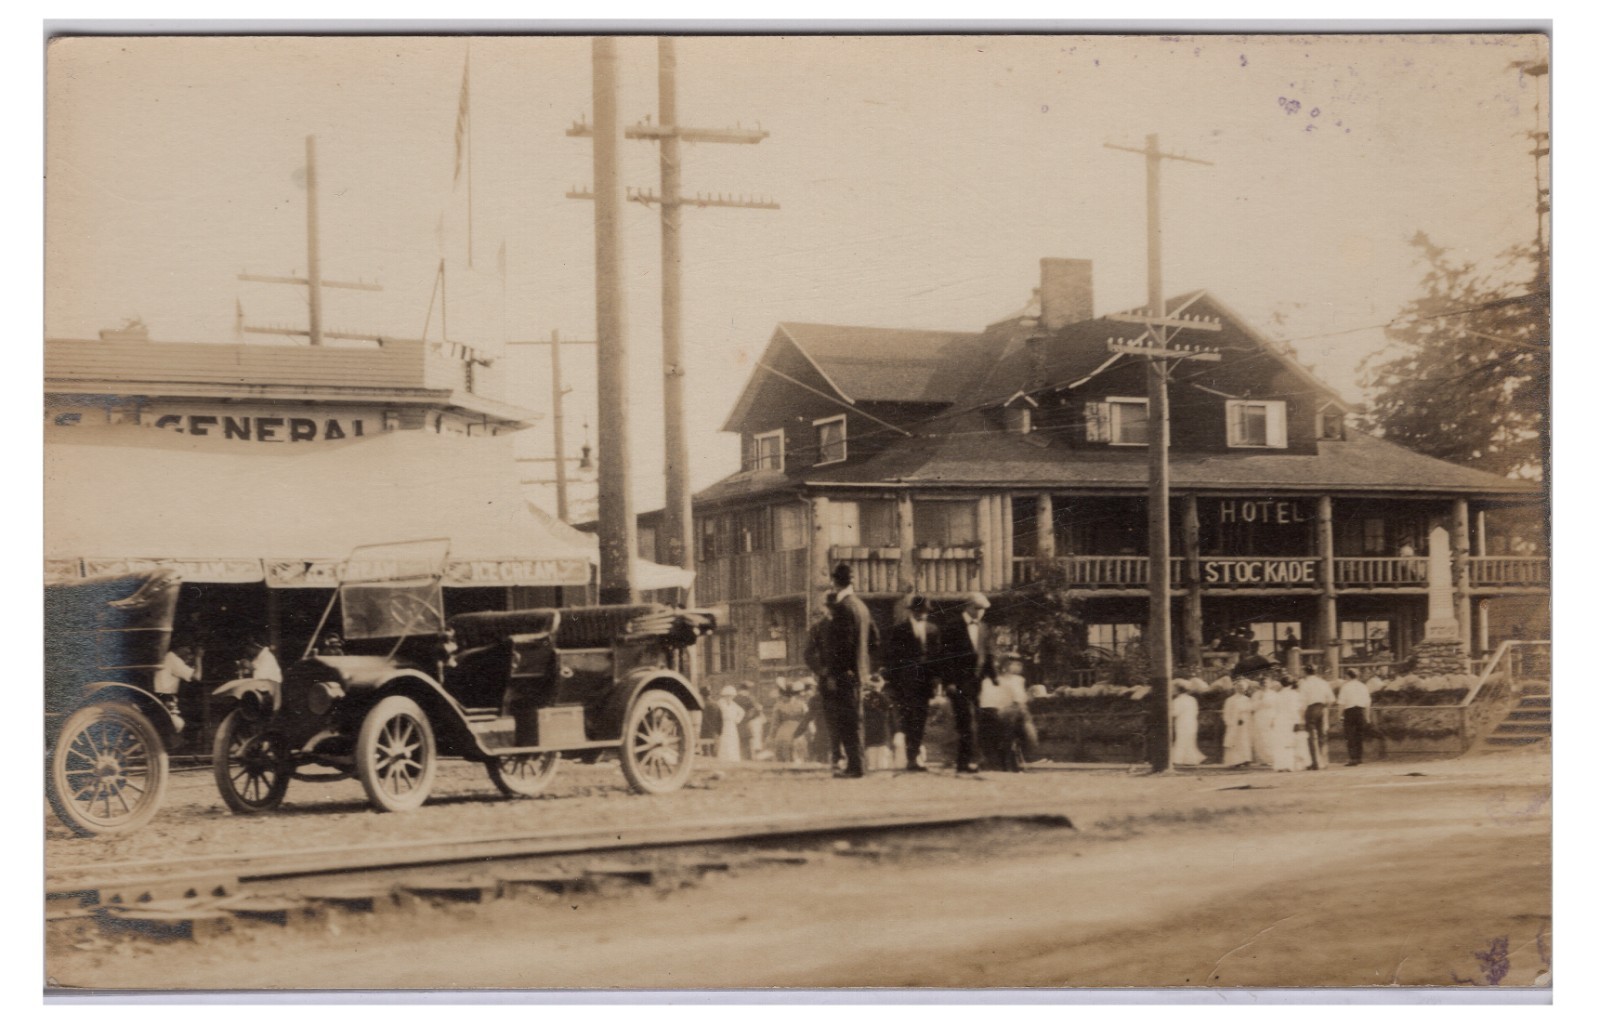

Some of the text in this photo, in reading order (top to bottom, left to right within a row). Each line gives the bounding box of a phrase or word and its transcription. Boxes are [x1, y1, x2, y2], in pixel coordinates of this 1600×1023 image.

[1220, 501, 1305, 525] HOTEL
[471, 562, 557, 582] ICE CREAM
[1205, 561, 1316, 583] STOCKADE
